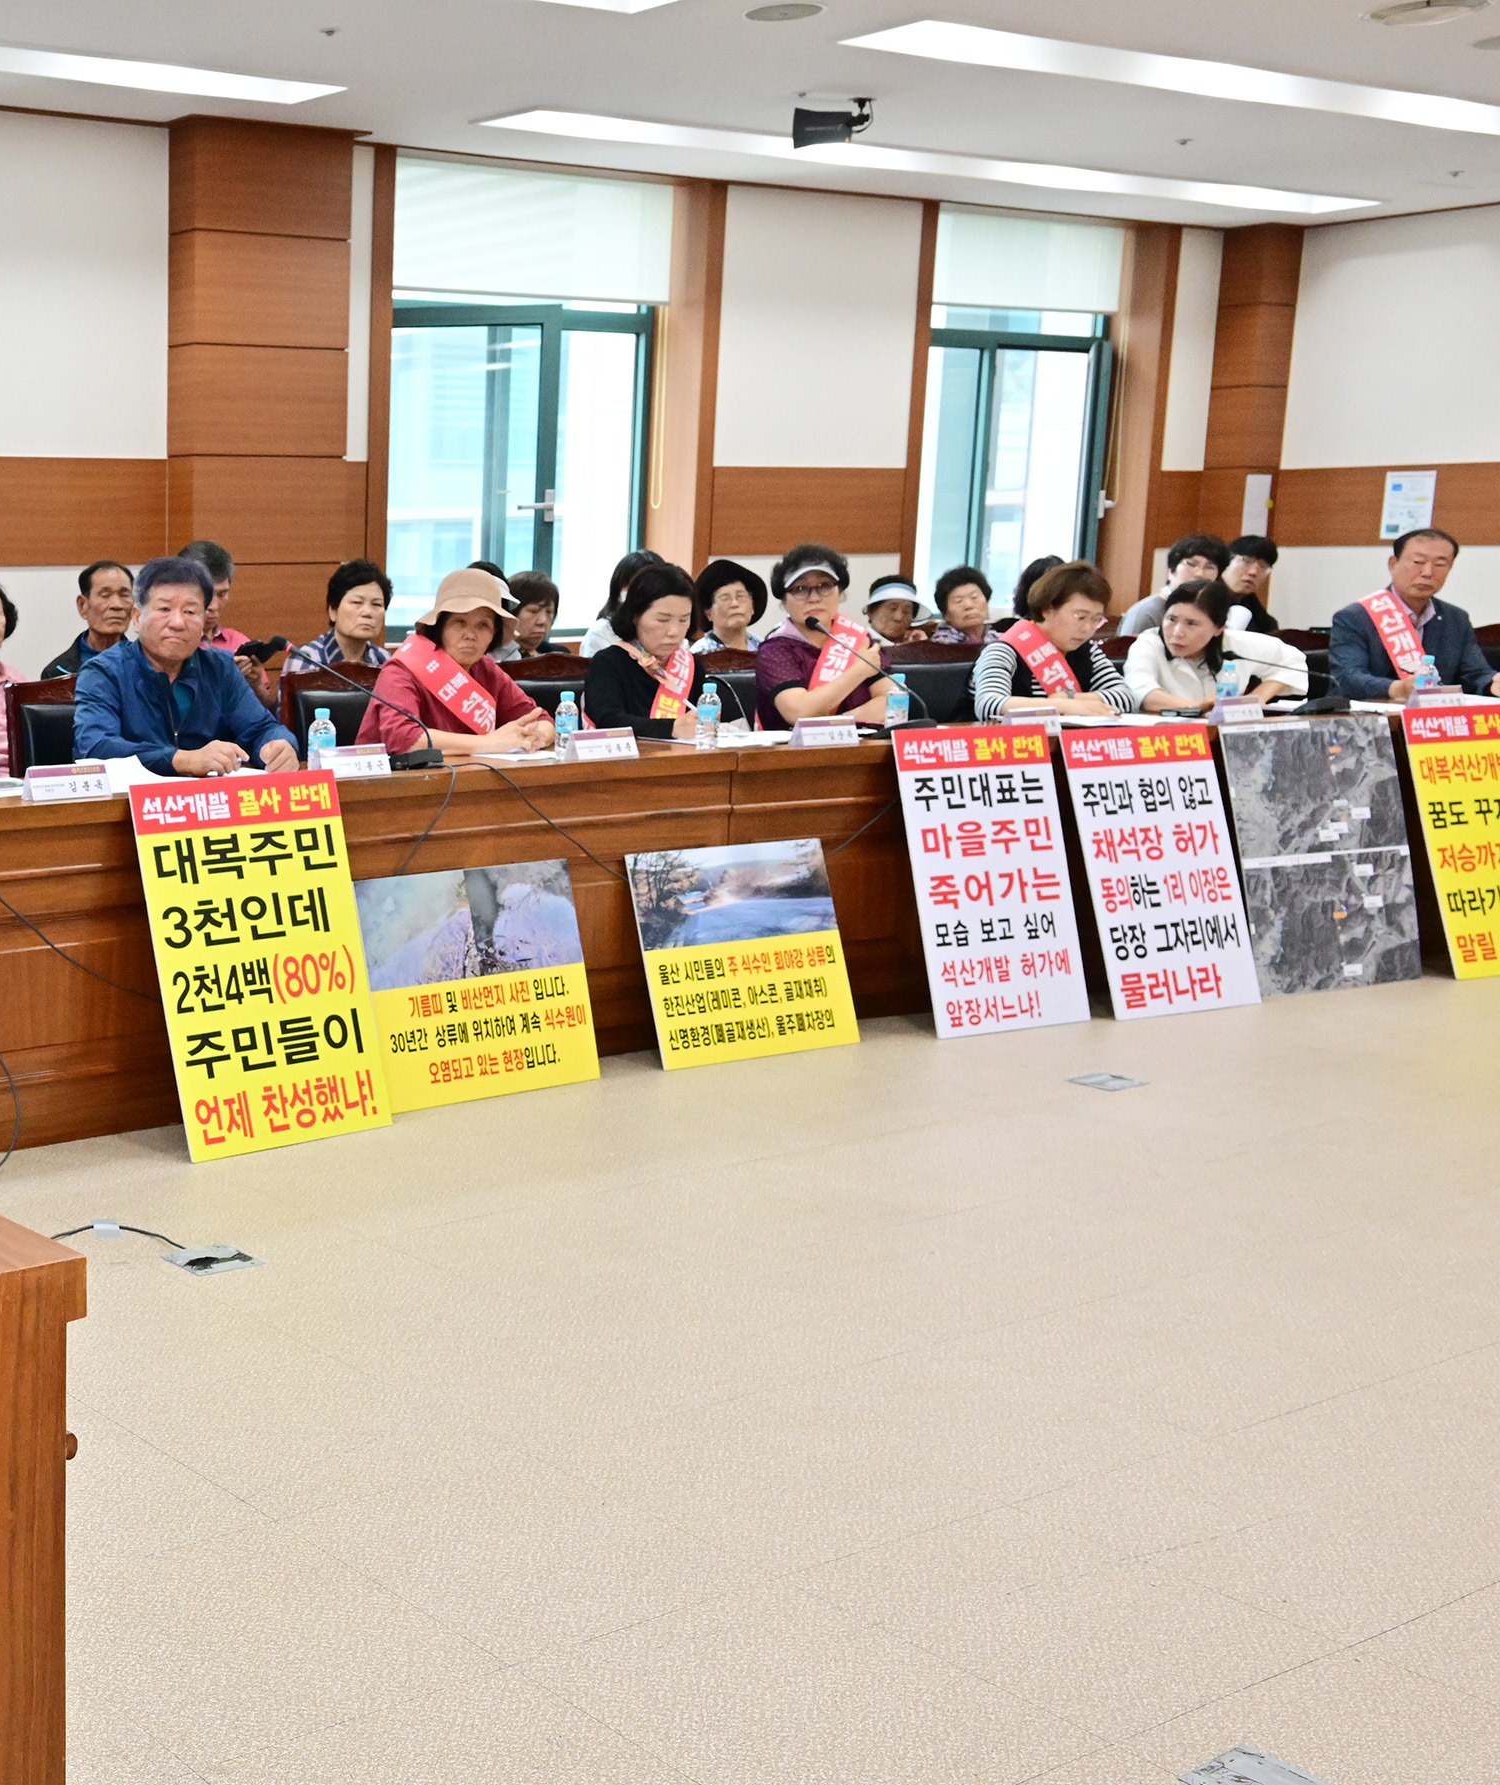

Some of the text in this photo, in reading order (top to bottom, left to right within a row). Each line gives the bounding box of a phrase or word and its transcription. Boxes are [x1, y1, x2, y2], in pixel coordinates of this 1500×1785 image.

[1370, 596, 1422, 673] 석산개발
[438, 672, 469, 702] 대복
[1070, 733, 1206, 762] 석산개발 결사 반대
[1410, 715, 1470, 738] 석산개발
[903, 735, 1044, 764] 석산개발 결사 반대
[142, 782, 332, 825] 석산개발 결사 반대
[914, 771, 1044, 812] 주민대표는
[1081, 775, 1213, 817] 주민과 협의 않고
[1428, 801, 1468, 829] 꿈도
[153, 824, 338, 884] 대복주민
[921, 816, 1053, 859] 마을주민
[1092, 820, 1219, 864] 채석장 허가
[1437, 841, 1500, 873] 저승까
[928, 866, 1061, 910] 죽어가는
[1100, 866, 1233, 914] 동의하는 1리 이장은
[162, 887, 330, 949] 3천인데
[935, 911, 1056, 947] 모습 보고 싶어
[1109, 912, 1241, 961] 당장 그자리에서
[659, 964, 681, 986] 울산
[684, 957, 726, 982] 시민들의
[727, 956, 739, 977] 주
[741, 952, 772, 975] 식수인
[806, 944, 836, 967] 상류의
[941, 948, 1072, 988] 석산개발 허가에
[1456, 931, 1498, 963] 말릴
[172, 944, 355, 1014] 2천4백(80%)
[408, 975, 569, 1018] 기름띠 및 비산먼지 사진 입니다.
[748, 983, 783, 1006] 아스콘,
[1120, 963, 1222, 1009] 물러나라
[390, 1004, 587, 1054] 30년간 상류에 위치하여 계속 식수원이
[946, 990, 1042, 1028] 앞장서느냐!
[186, 1007, 364, 1079] 주민들이
[429, 1043, 561, 1084] 오염되고 있는 현장입니다.
[195, 1069, 378, 1146] 언제 찬성했냐!
